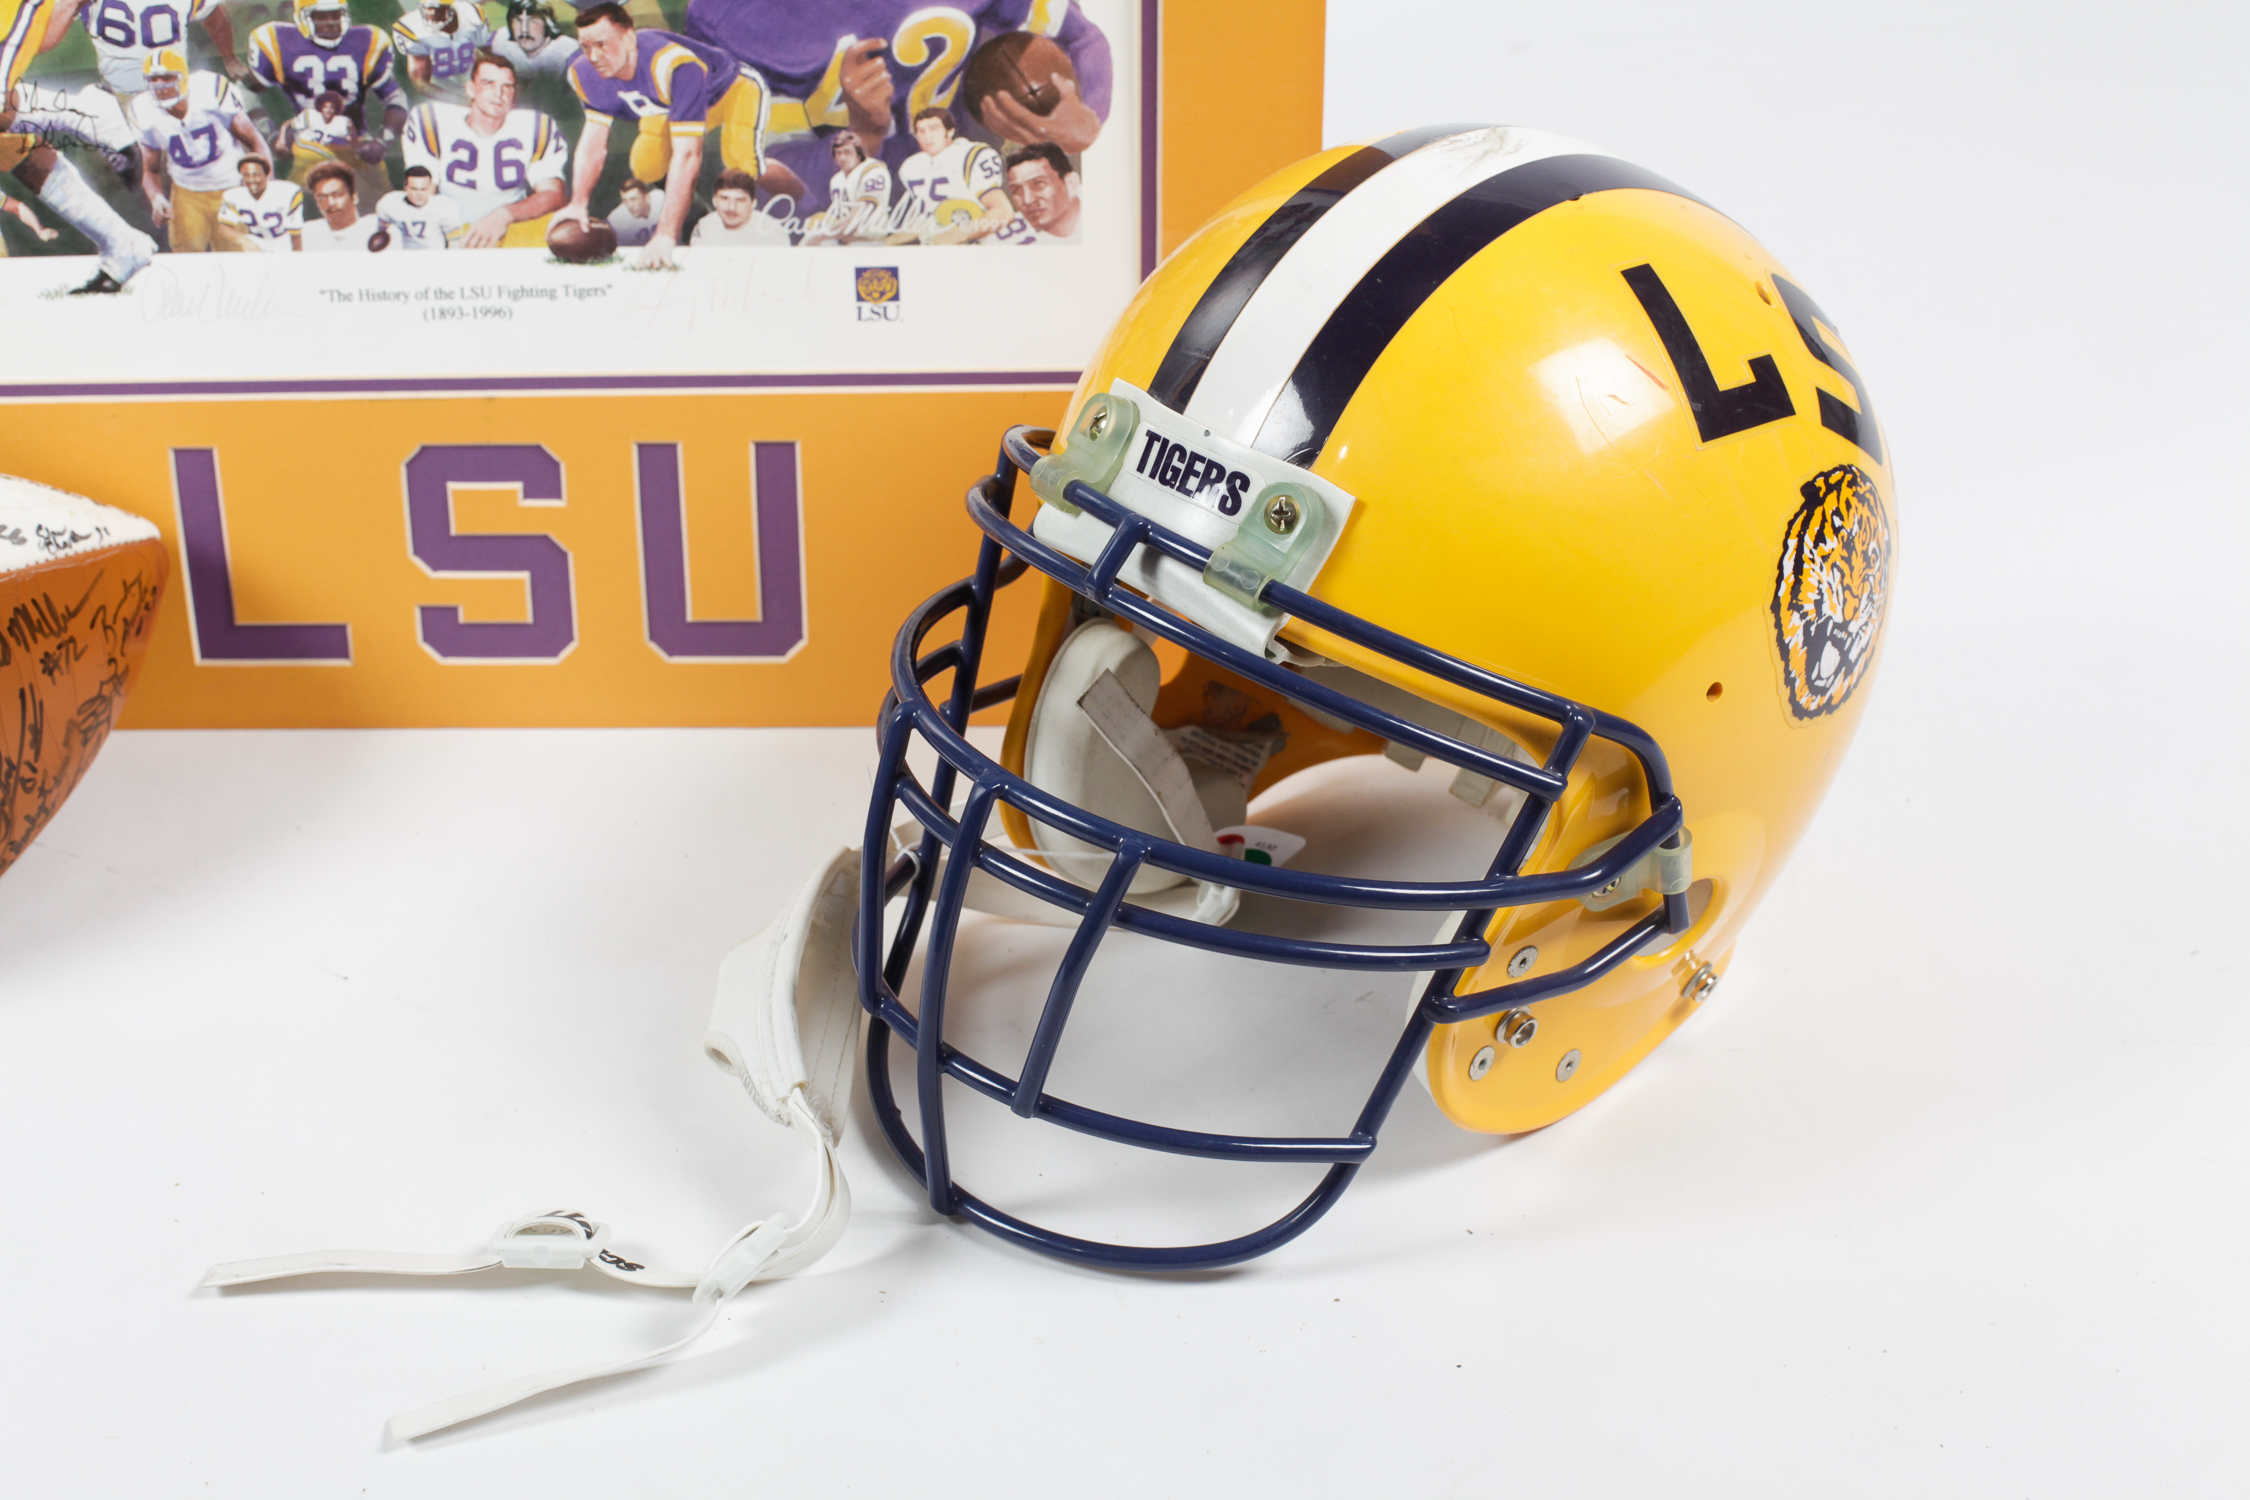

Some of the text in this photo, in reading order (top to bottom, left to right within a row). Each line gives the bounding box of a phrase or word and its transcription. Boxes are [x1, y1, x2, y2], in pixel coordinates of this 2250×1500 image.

[96, 0, 181, 49] 60
[292, 54, 360, 106] 33
[168, 122, 226, 169] 47
[446, 138, 526, 191] 26
[319, 282, 614, 305] "The History of the LSU Fighting Tigers"
[422, 305, 514, 322] (1893-1996)
[856, 304, 901, 322] LSU
[1135, 428, 1251, 517] TIGERS
[169, 440, 808, 667] LSU
